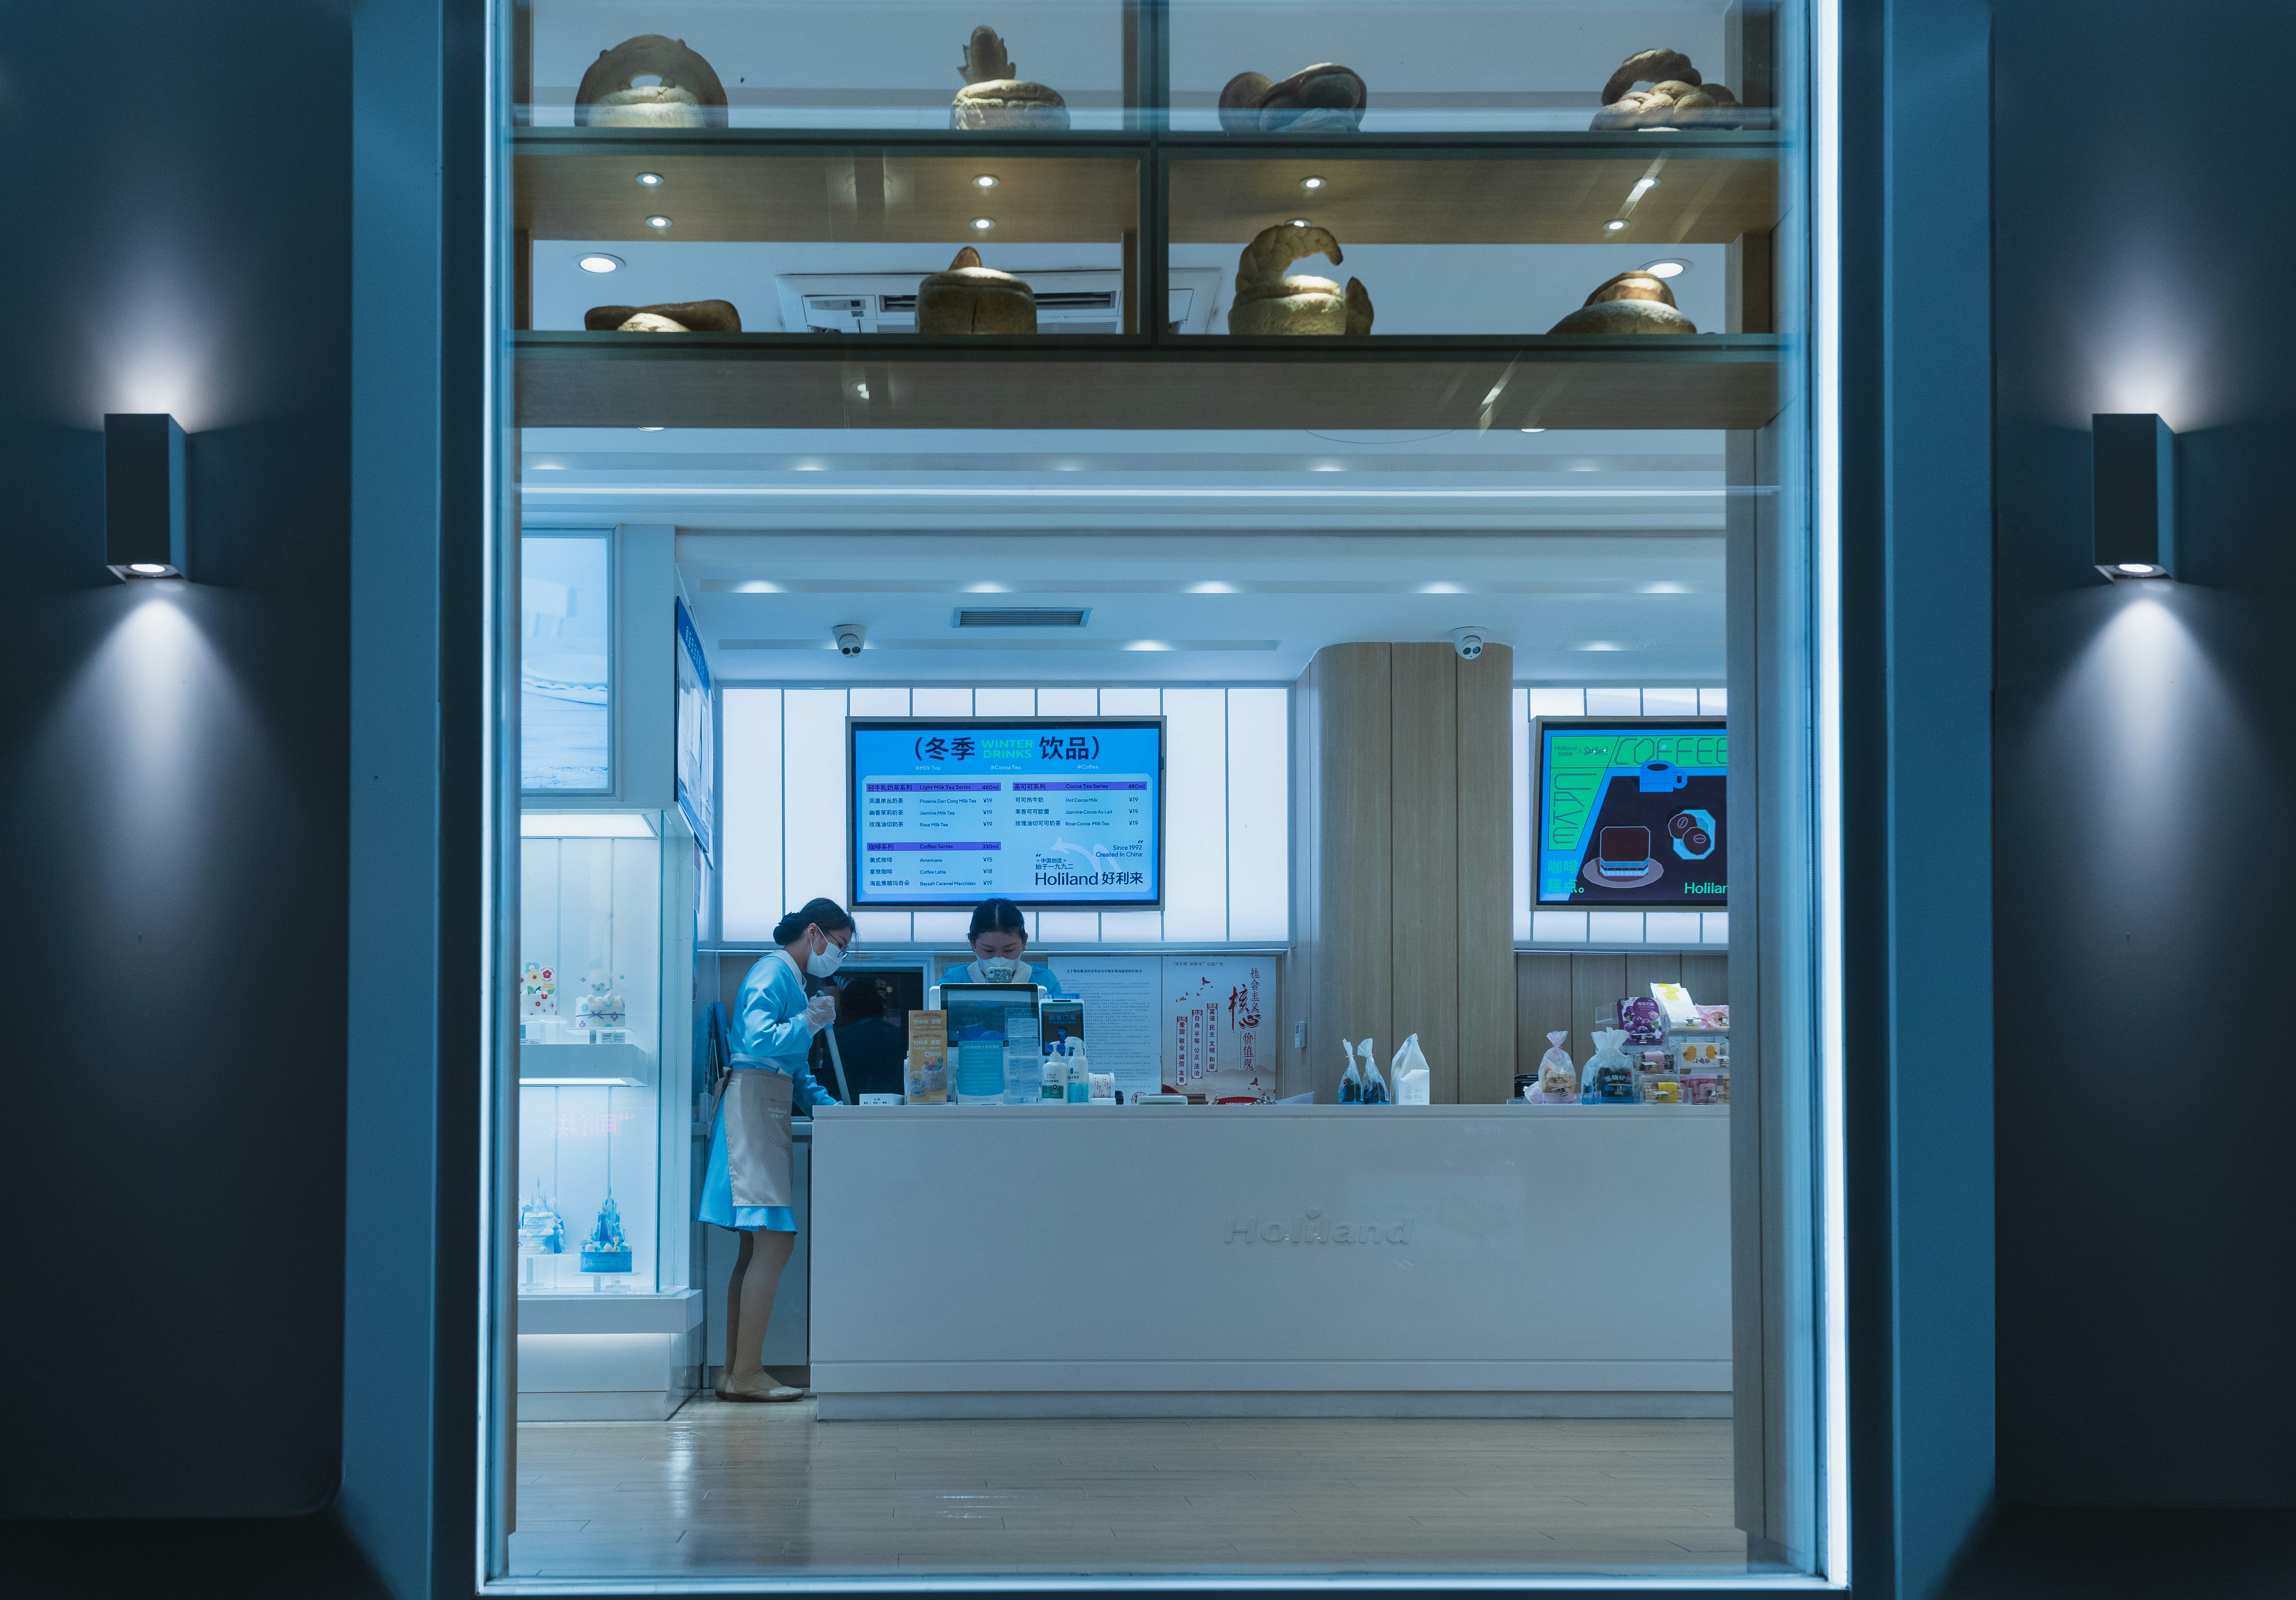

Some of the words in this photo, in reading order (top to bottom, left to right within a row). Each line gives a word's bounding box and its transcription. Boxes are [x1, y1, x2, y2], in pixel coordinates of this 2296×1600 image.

[981, 740, 1033, 748] WINTER
[983, 750, 1032, 758] DRINKS
[1614, 738, 1728, 765] COFFEE
[1547, 859, 1579, 874] 咖啡
[1035, 872, 1098, 886] Holiland
[1101, 871, 1143, 885] 好利来
[1250, 968, 1260, 1012] 社会主义
[1194, 1015, 1200, 1028] 自由
[1209, 1009, 1215, 1022] 富强
[1179, 1022, 1185, 1035] 爱国
[1209, 1024, 1215, 1038] 民主
[1194, 1031, 1200, 1044] 平等
[1179, 1038, 1185, 1051] 敬业
[1209, 1040, 1215, 1054] 文明
[1243, 1032, 1254, 1070] 价值观
[1194, 1047, 1200, 1060] 公正
[1179, 1054, 1185, 1067] 诚信
[1209, 1057, 1215, 1070] 和谐
[1194, 1063, 1200, 1076] 法治
[1179, 1070, 1185, 1083] 友善
[1223, 1208, 1414, 1243] Holiland
